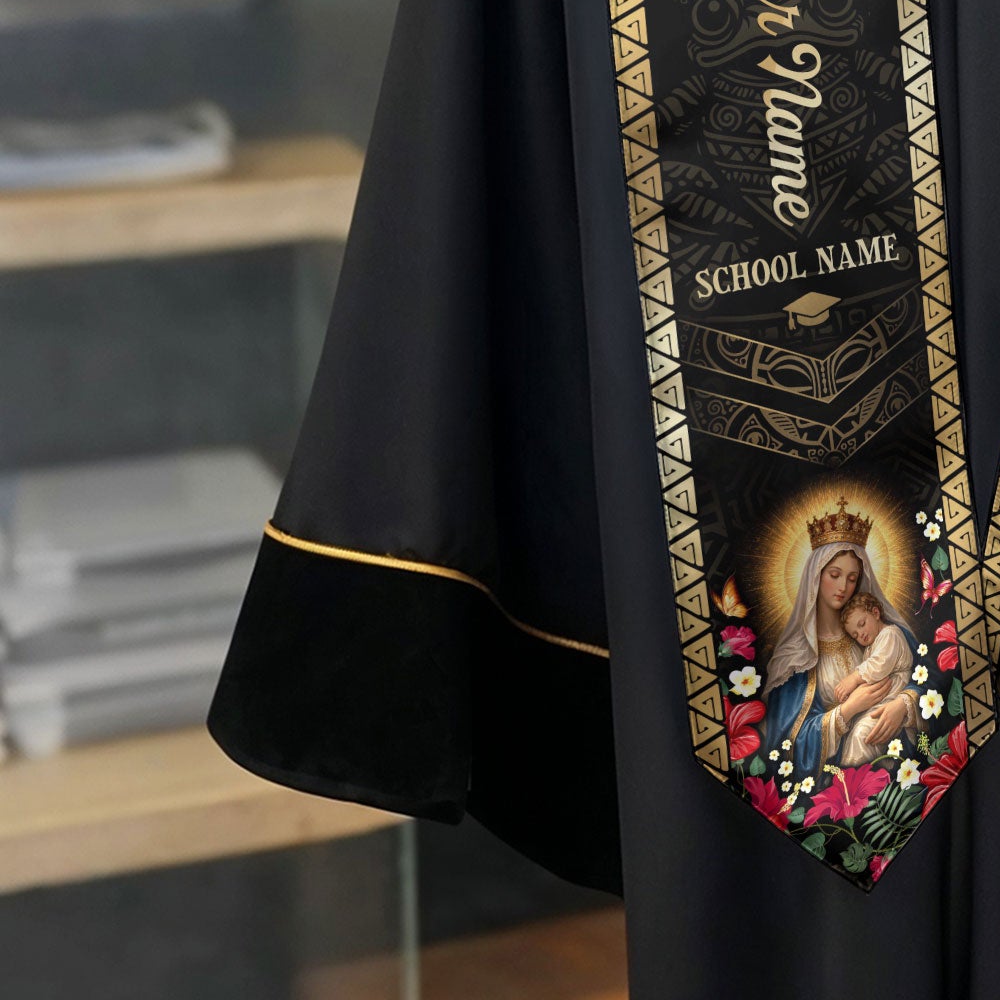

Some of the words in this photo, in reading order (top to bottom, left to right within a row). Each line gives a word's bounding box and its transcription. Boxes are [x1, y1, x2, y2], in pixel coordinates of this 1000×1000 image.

[757, 43, 821, 228] Name
[695, 251, 806, 300] SCHOOL
[816, 233, 899, 277] NAME
